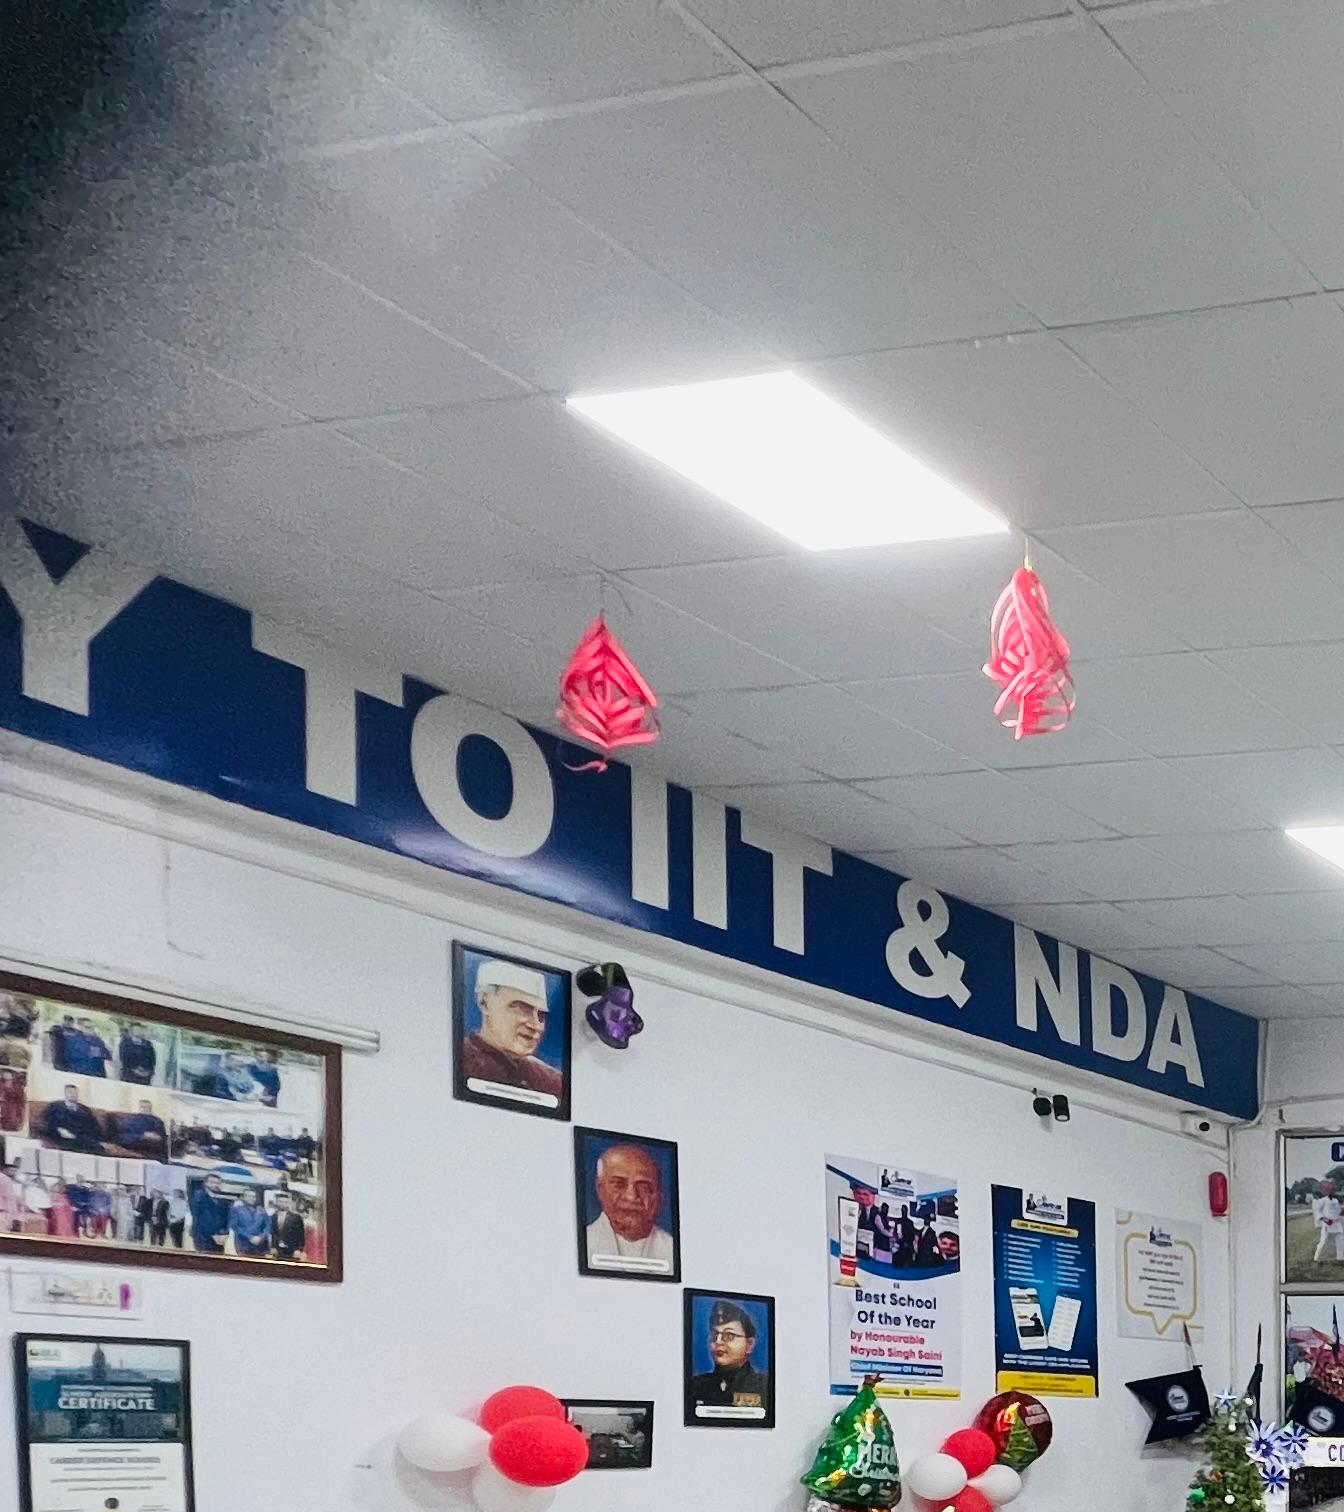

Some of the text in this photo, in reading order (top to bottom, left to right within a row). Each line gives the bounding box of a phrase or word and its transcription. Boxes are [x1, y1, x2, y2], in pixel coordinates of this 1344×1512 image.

[251, 606, 554, 858] TO
[631, 765, 833, 955] IIT
[886, 880, 972, 1009] &
[1013, 922, 1205, 1088] NDA
[855, 1289, 937, 1310] Best School
[857, 1310, 936, 1329] Of the Year
[850, 1330, 925, 1345] by Honourable
[850, 1345, 942, 1360] Nayab Singh Saini
[58, 1397, 156, 1411] CERTIFICATE
